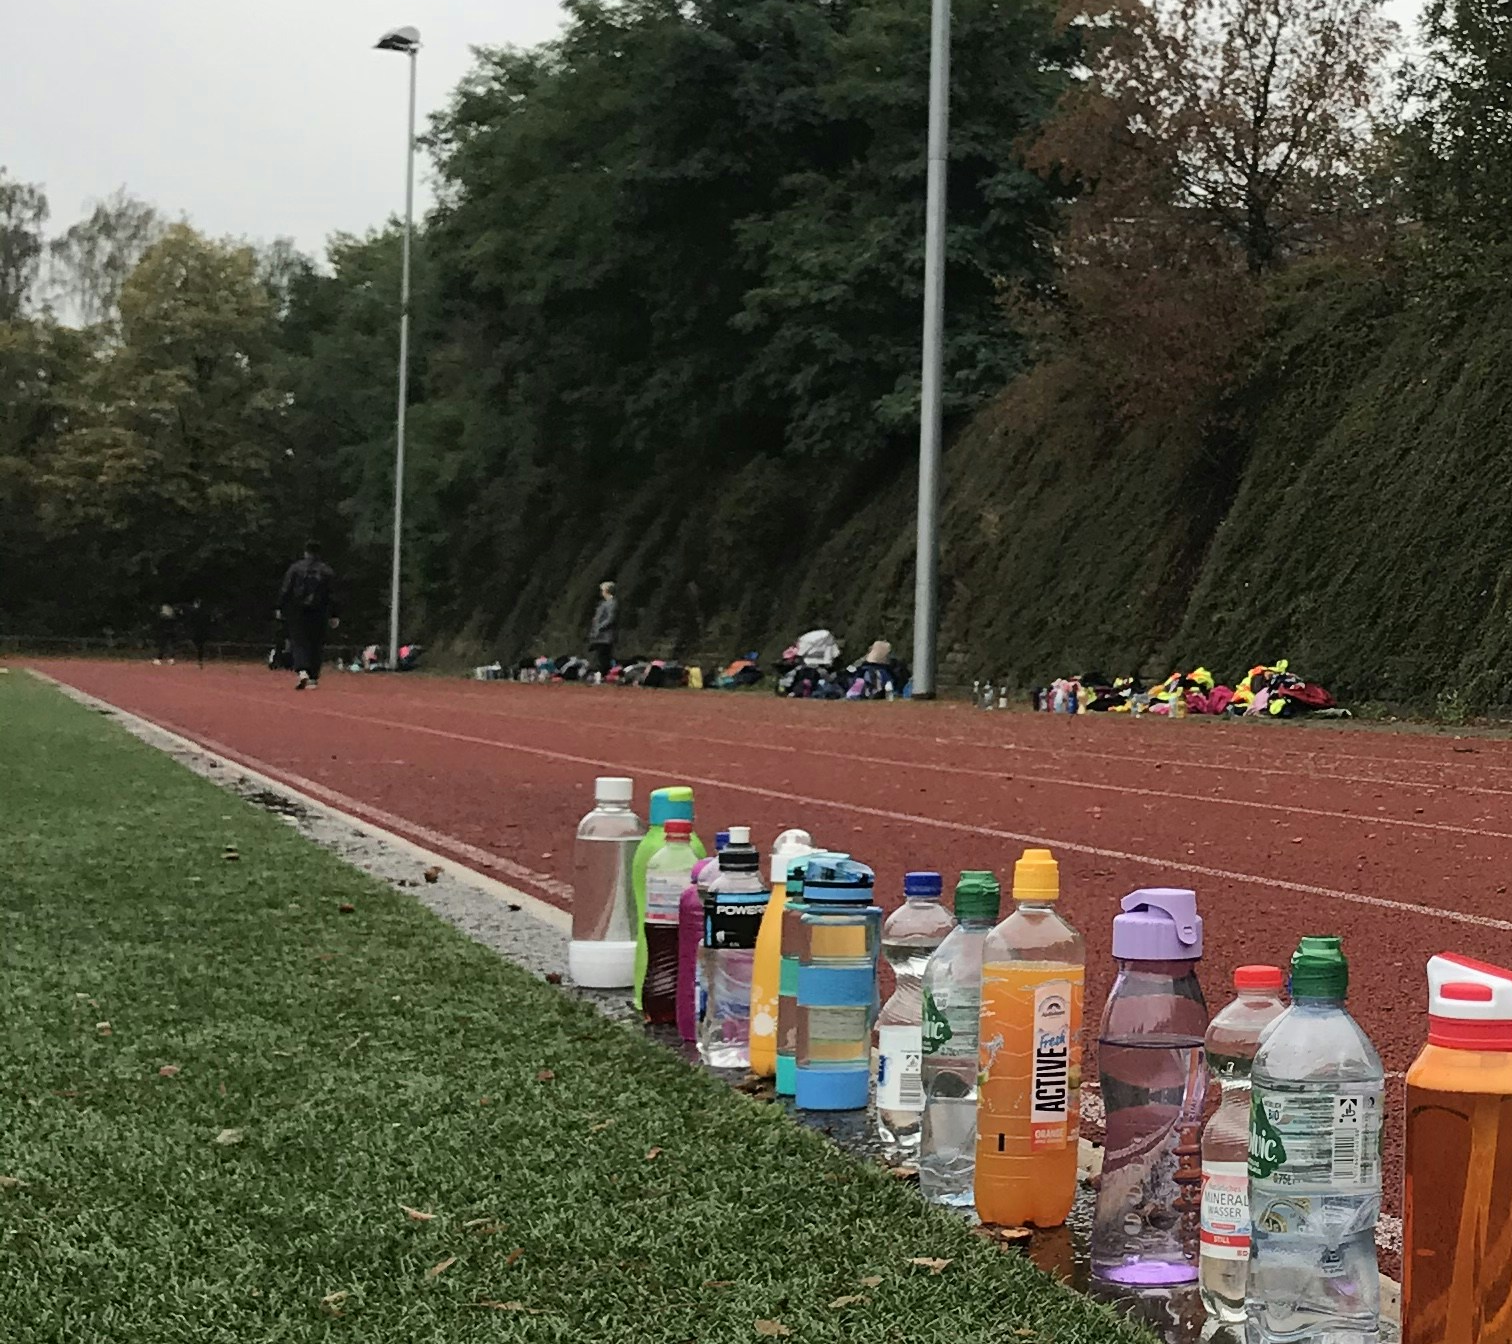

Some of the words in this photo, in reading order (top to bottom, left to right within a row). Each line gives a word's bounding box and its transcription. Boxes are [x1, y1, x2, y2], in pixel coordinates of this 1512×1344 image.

[1040, 1030, 1066, 1048] Fresh
[1035, 1047, 1067, 1113] ACTIVE
[1205, 1191, 1249, 1207] MINERAL
[1207, 1205, 1242, 1218] WASSER
